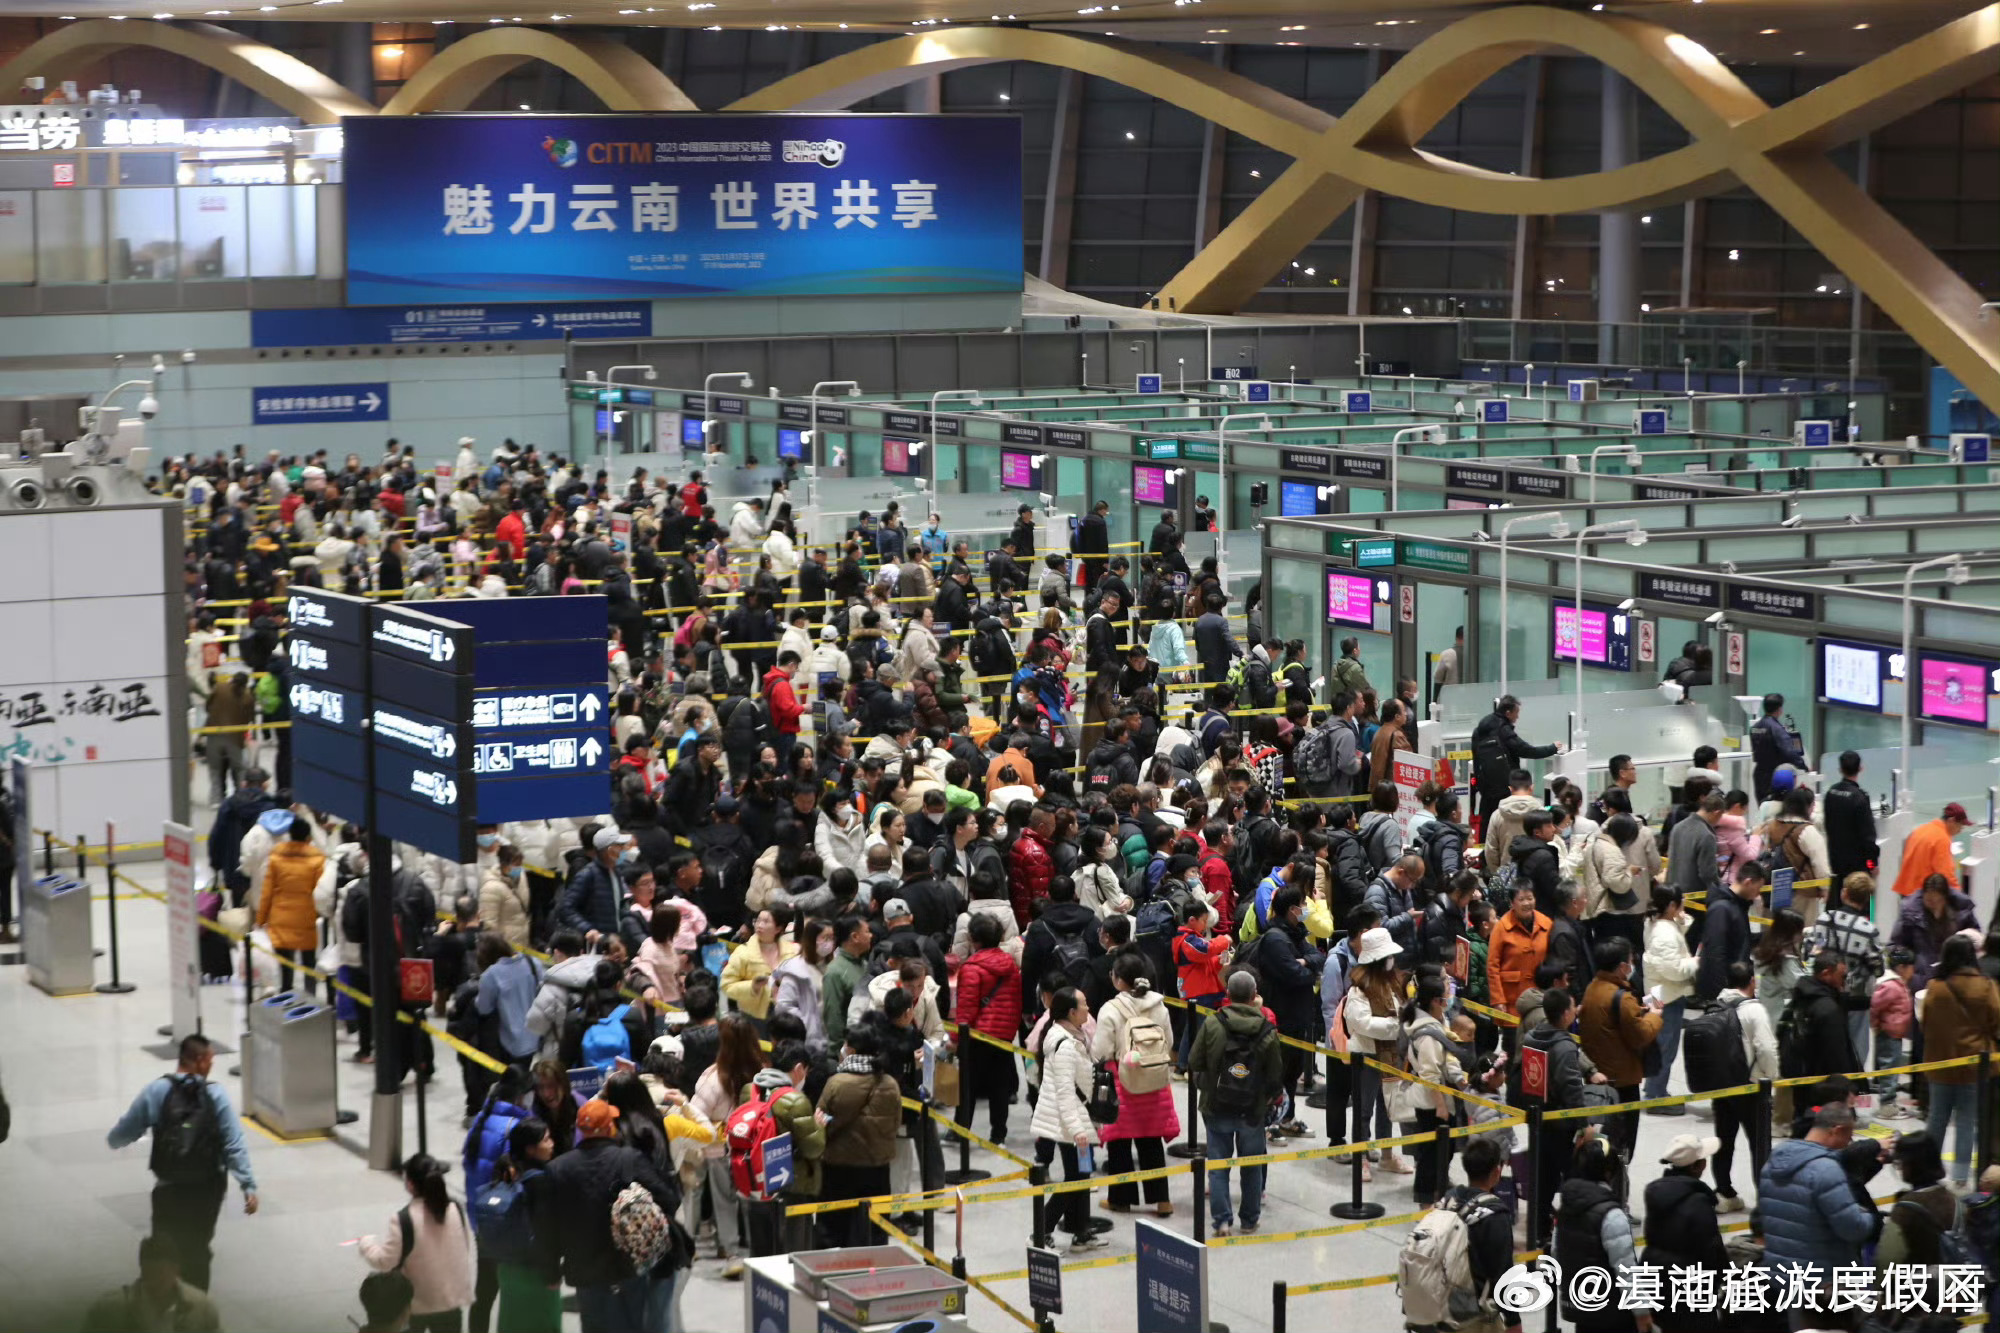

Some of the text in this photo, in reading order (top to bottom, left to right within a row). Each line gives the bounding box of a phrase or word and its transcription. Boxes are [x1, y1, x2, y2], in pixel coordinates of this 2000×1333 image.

[587, 142, 653, 164] CITM
[784, 151, 817, 161] China
[443, 179, 939, 236] 魅力云南 世界共享
[1613, 614, 1627, 636] 11
[1400, 765, 1425, 781] 安检提示
[944, 1297, 956, 1307] 15
[1148, 1277, 1191, 1313] 温馨提示
